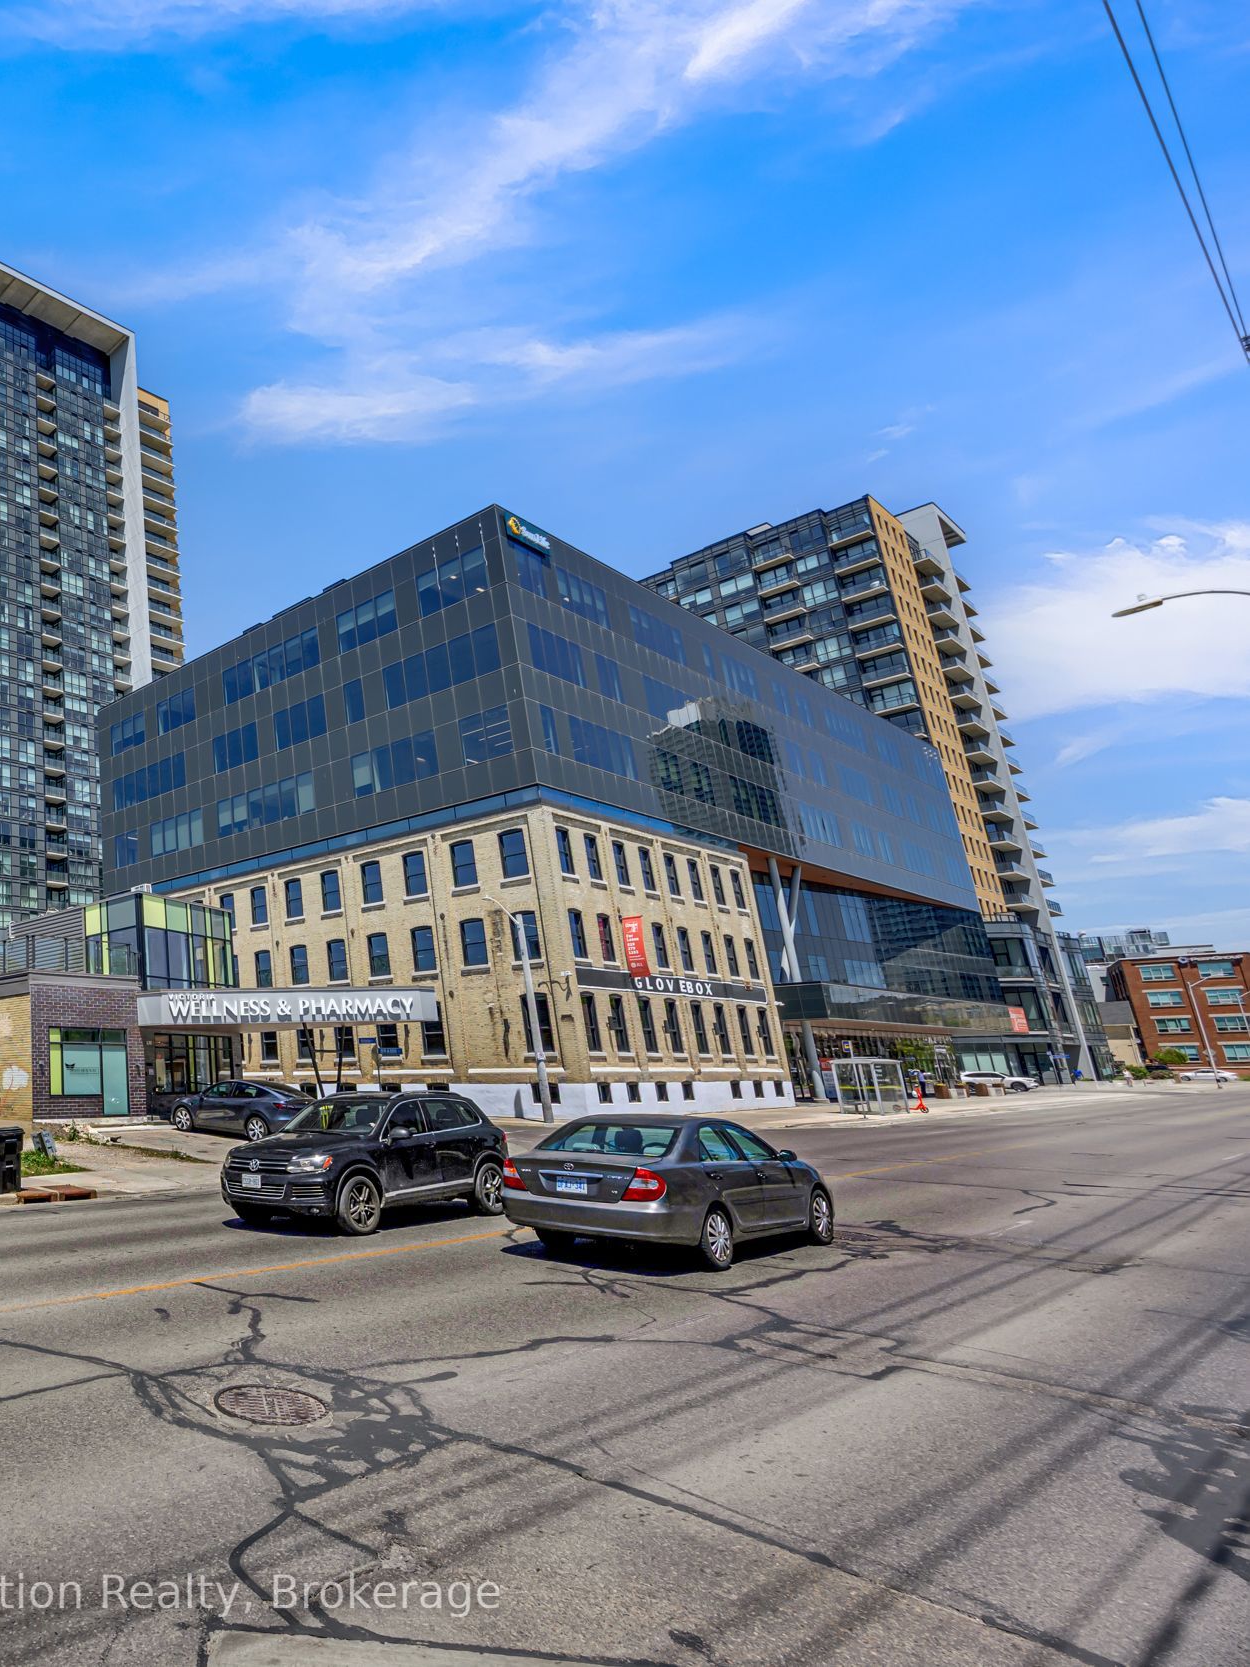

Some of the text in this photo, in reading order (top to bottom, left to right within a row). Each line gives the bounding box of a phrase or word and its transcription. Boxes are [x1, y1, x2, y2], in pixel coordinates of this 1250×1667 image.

[169, 997, 413, 1017] WELLNESS & PHARMACY
